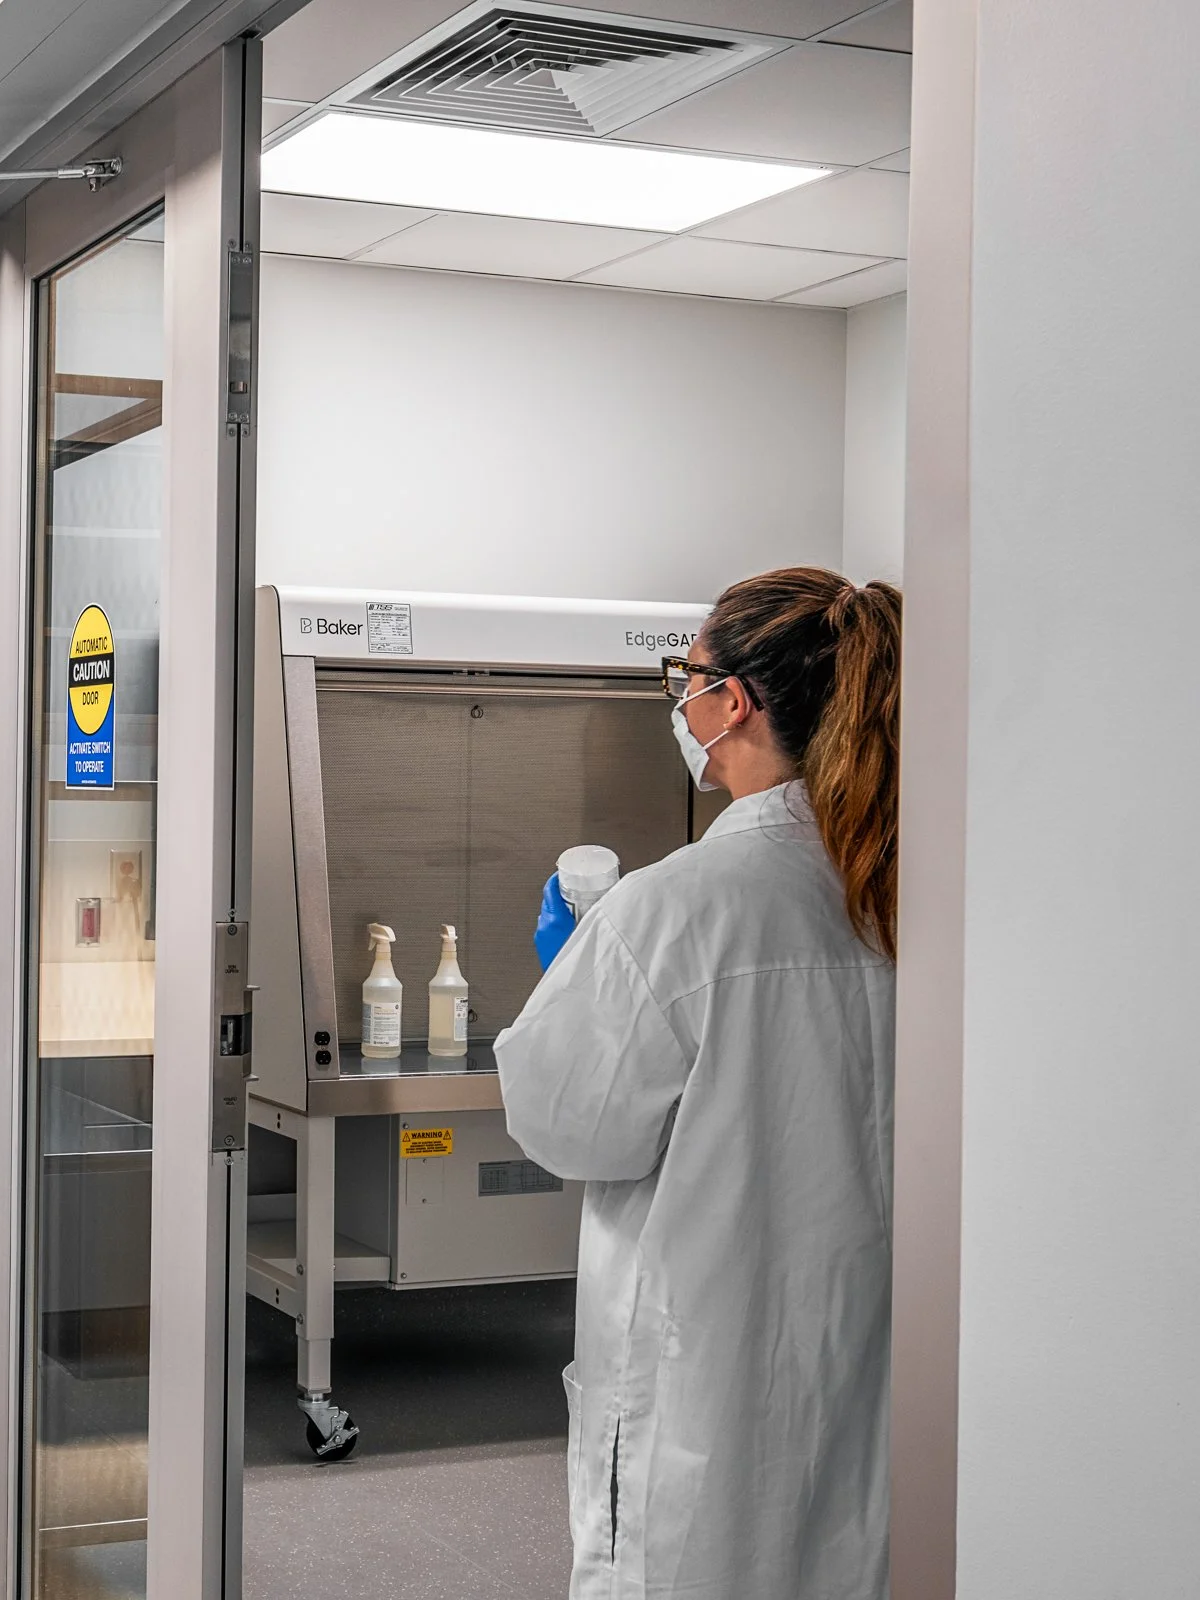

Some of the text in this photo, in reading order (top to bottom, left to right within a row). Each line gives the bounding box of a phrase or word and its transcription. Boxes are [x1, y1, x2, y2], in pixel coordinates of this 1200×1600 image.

[316, 618, 363, 636] Baker
[75, 636, 108, 655] AUTOMATIC
[73, 660, 110, 682] CAUTION
[82, 691, 99, 706] DOOR
[69, 741, 110, 755] ACTIVATE SWITCH
[75, 760, 104, 773] TO OPERATE
[411, 1131, 443, 1139] WARNING
